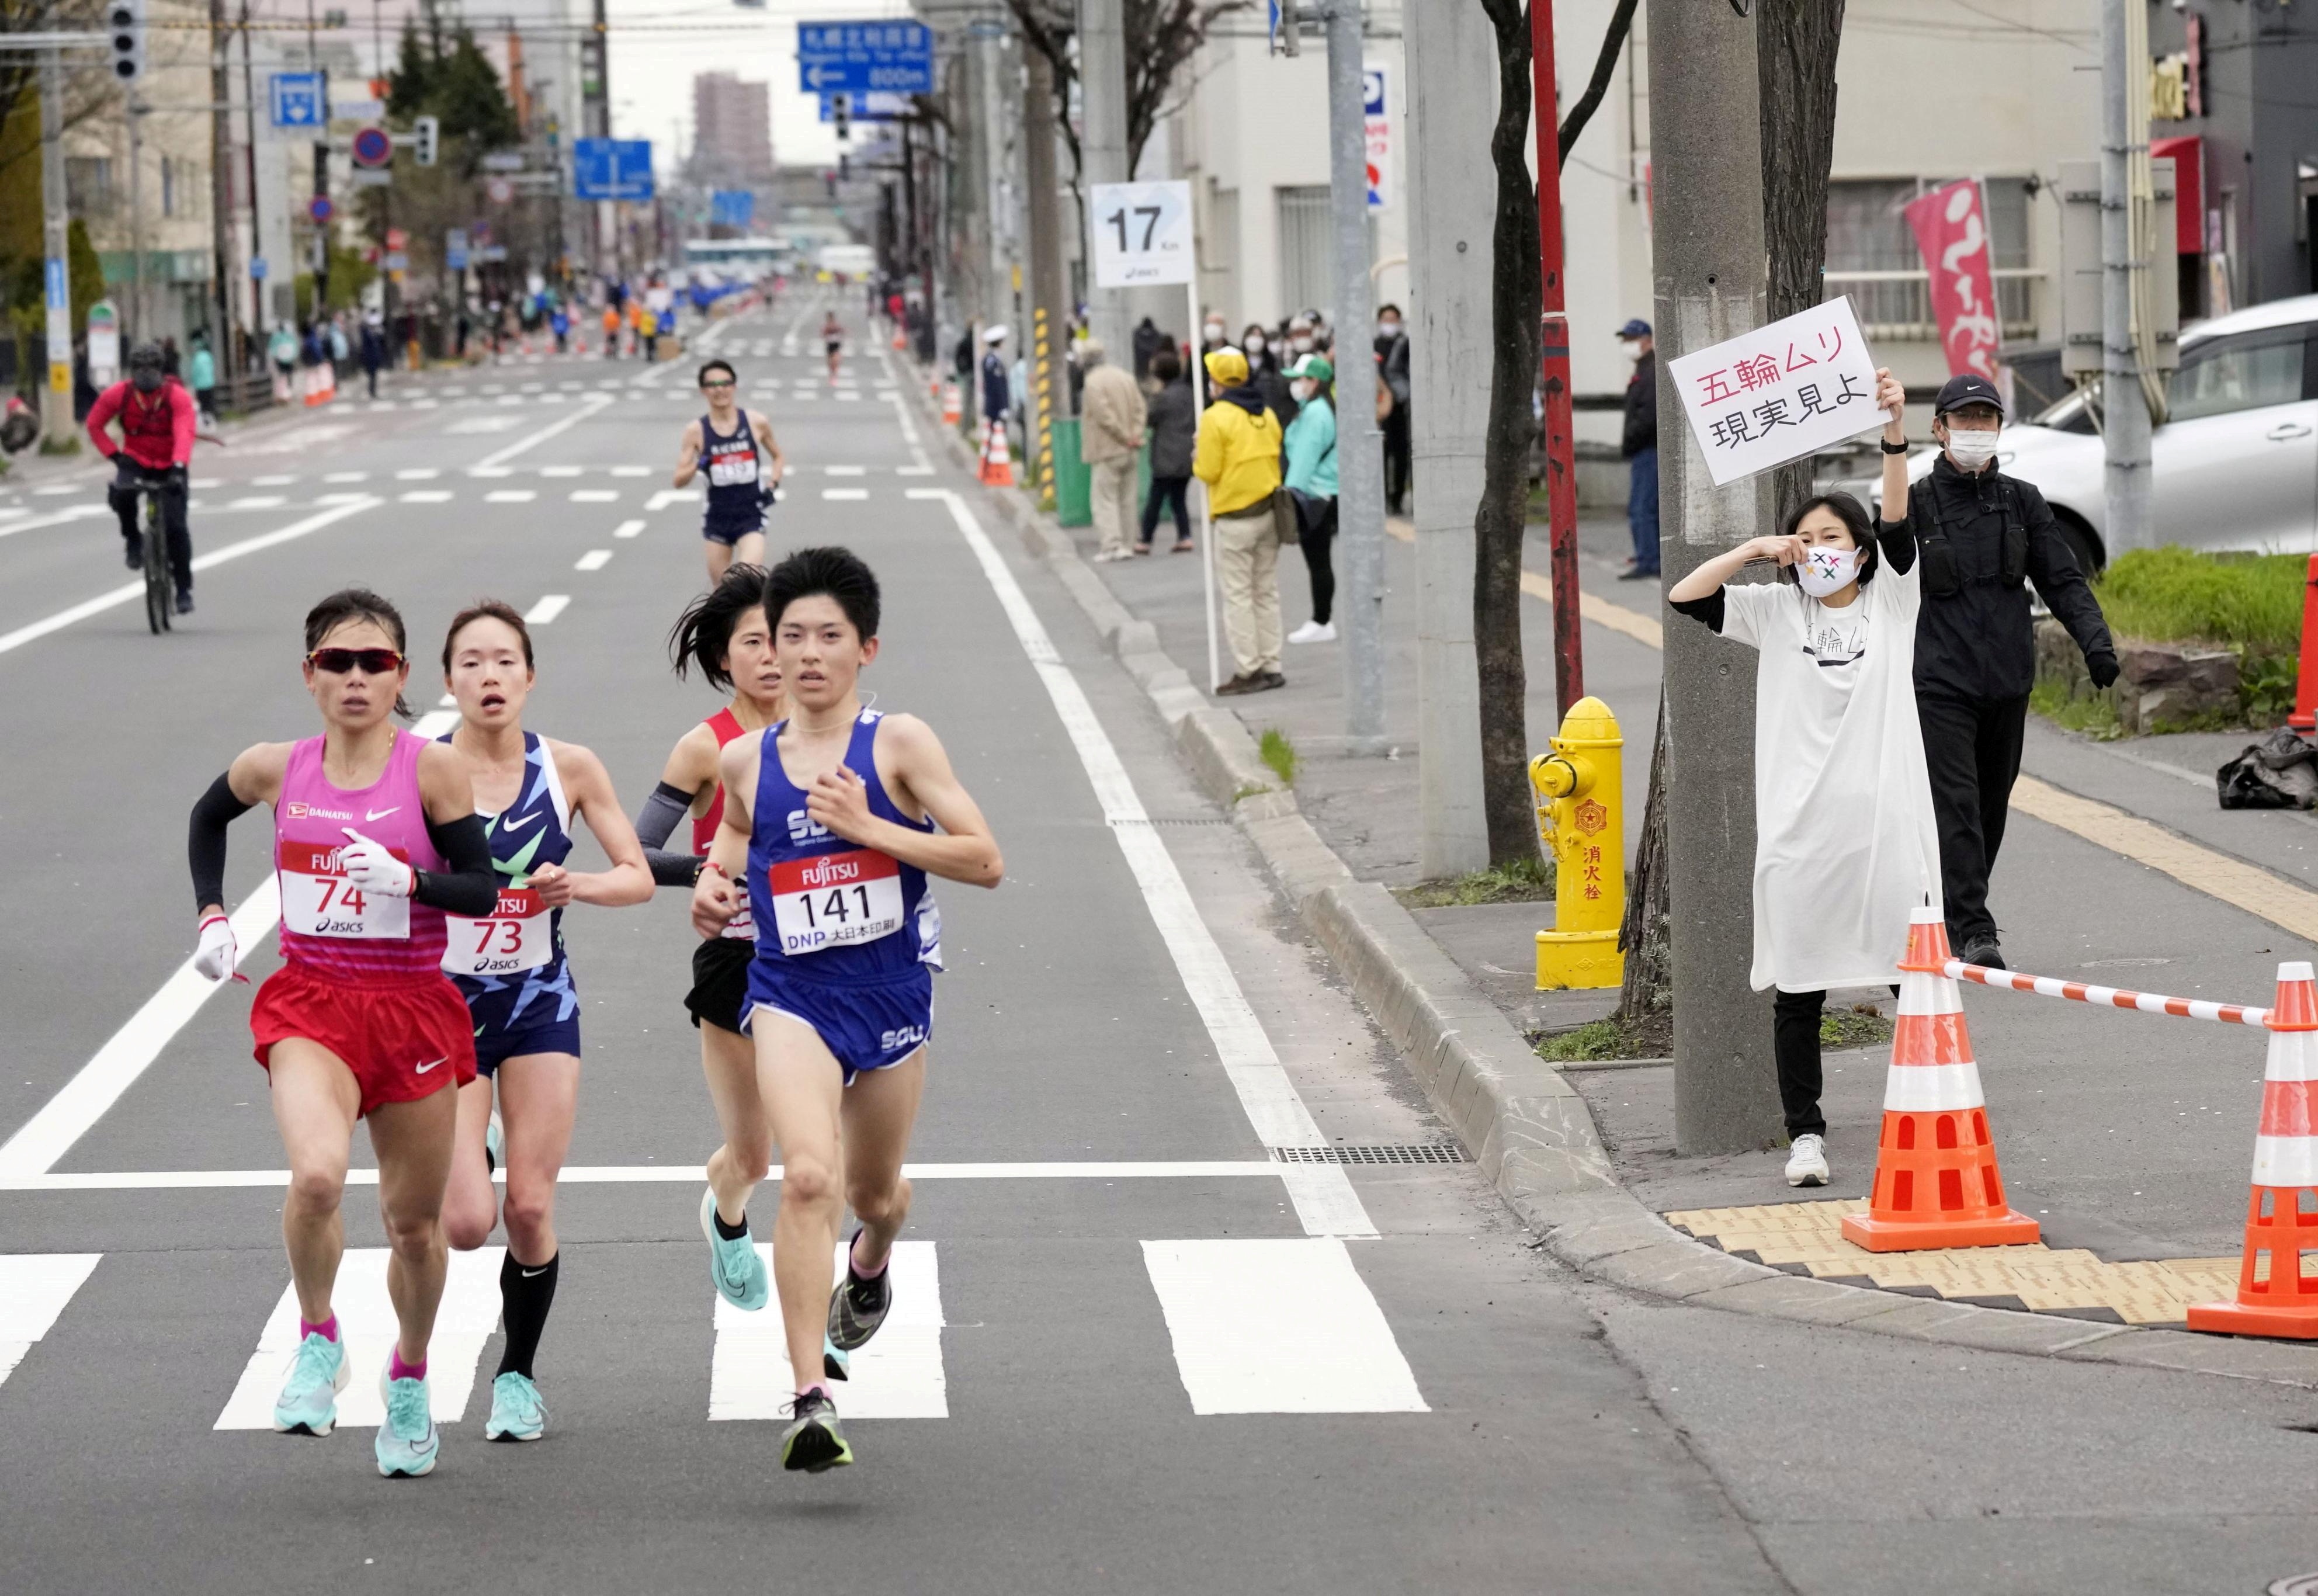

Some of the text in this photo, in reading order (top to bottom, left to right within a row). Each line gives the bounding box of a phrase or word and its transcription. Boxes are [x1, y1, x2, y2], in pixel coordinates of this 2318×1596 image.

[1108, 206, 1161, 252] 17
[1696, 325, 1842, 407] 五輪ムリ
[1709, 373, 1868, 449] 現実見よ
[308, 807, 353, 821] DAIHATSU
[801, 856, 859, 887] FUJITSU
[1584, 845, 1602, 901] 消火栓
[315, 878, 367, 915] 74
[800, 884, 870, 928] 141
[331, 921, 363, 933] asics
[473, 921, 522, 955] 73
[788, 918, 896, 949] DNP 大日本印刷
[489, 958, 519, 970] asics
